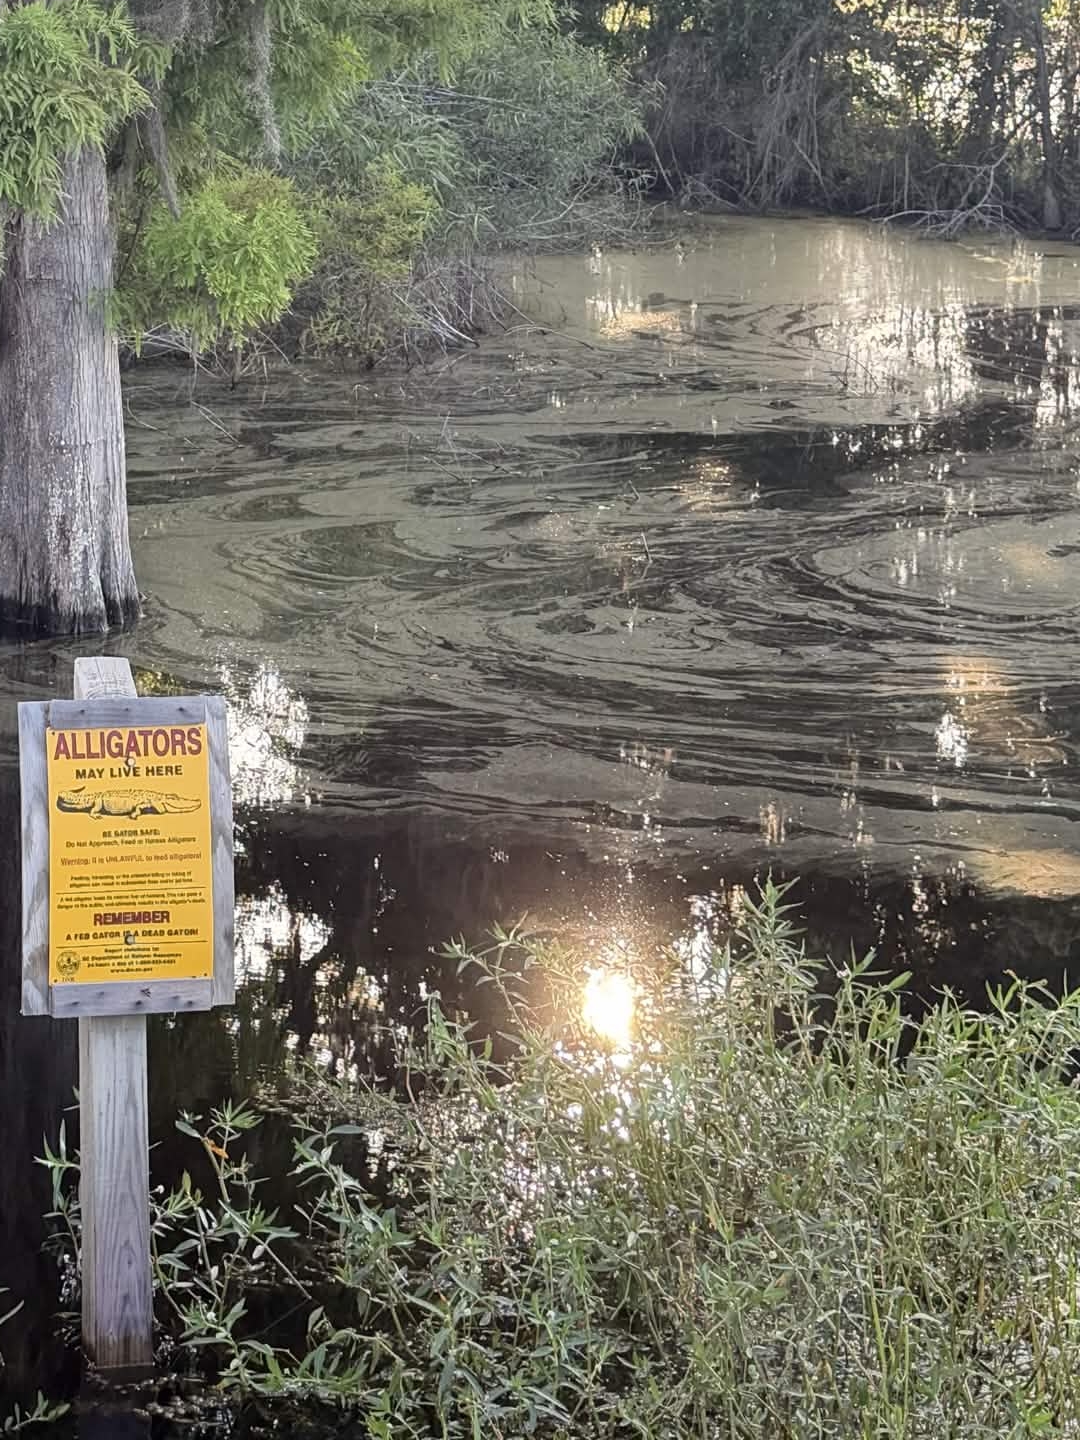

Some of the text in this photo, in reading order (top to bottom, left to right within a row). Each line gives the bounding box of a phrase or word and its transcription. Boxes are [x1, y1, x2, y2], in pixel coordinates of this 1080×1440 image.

[54, 728, 202, 760] ALLIGATORS
[75, 765, 183, 780] MAY LIVE HERE
[60, 857, 90, 866] Warning:
[93, 911, 170, 926] REMEMBER
[65, 933, 72, 941] A
[74, 933, 90, 941] FED
[92, 931, 120, 940] GATOR
[142, 929, 165, 937] DEAD
